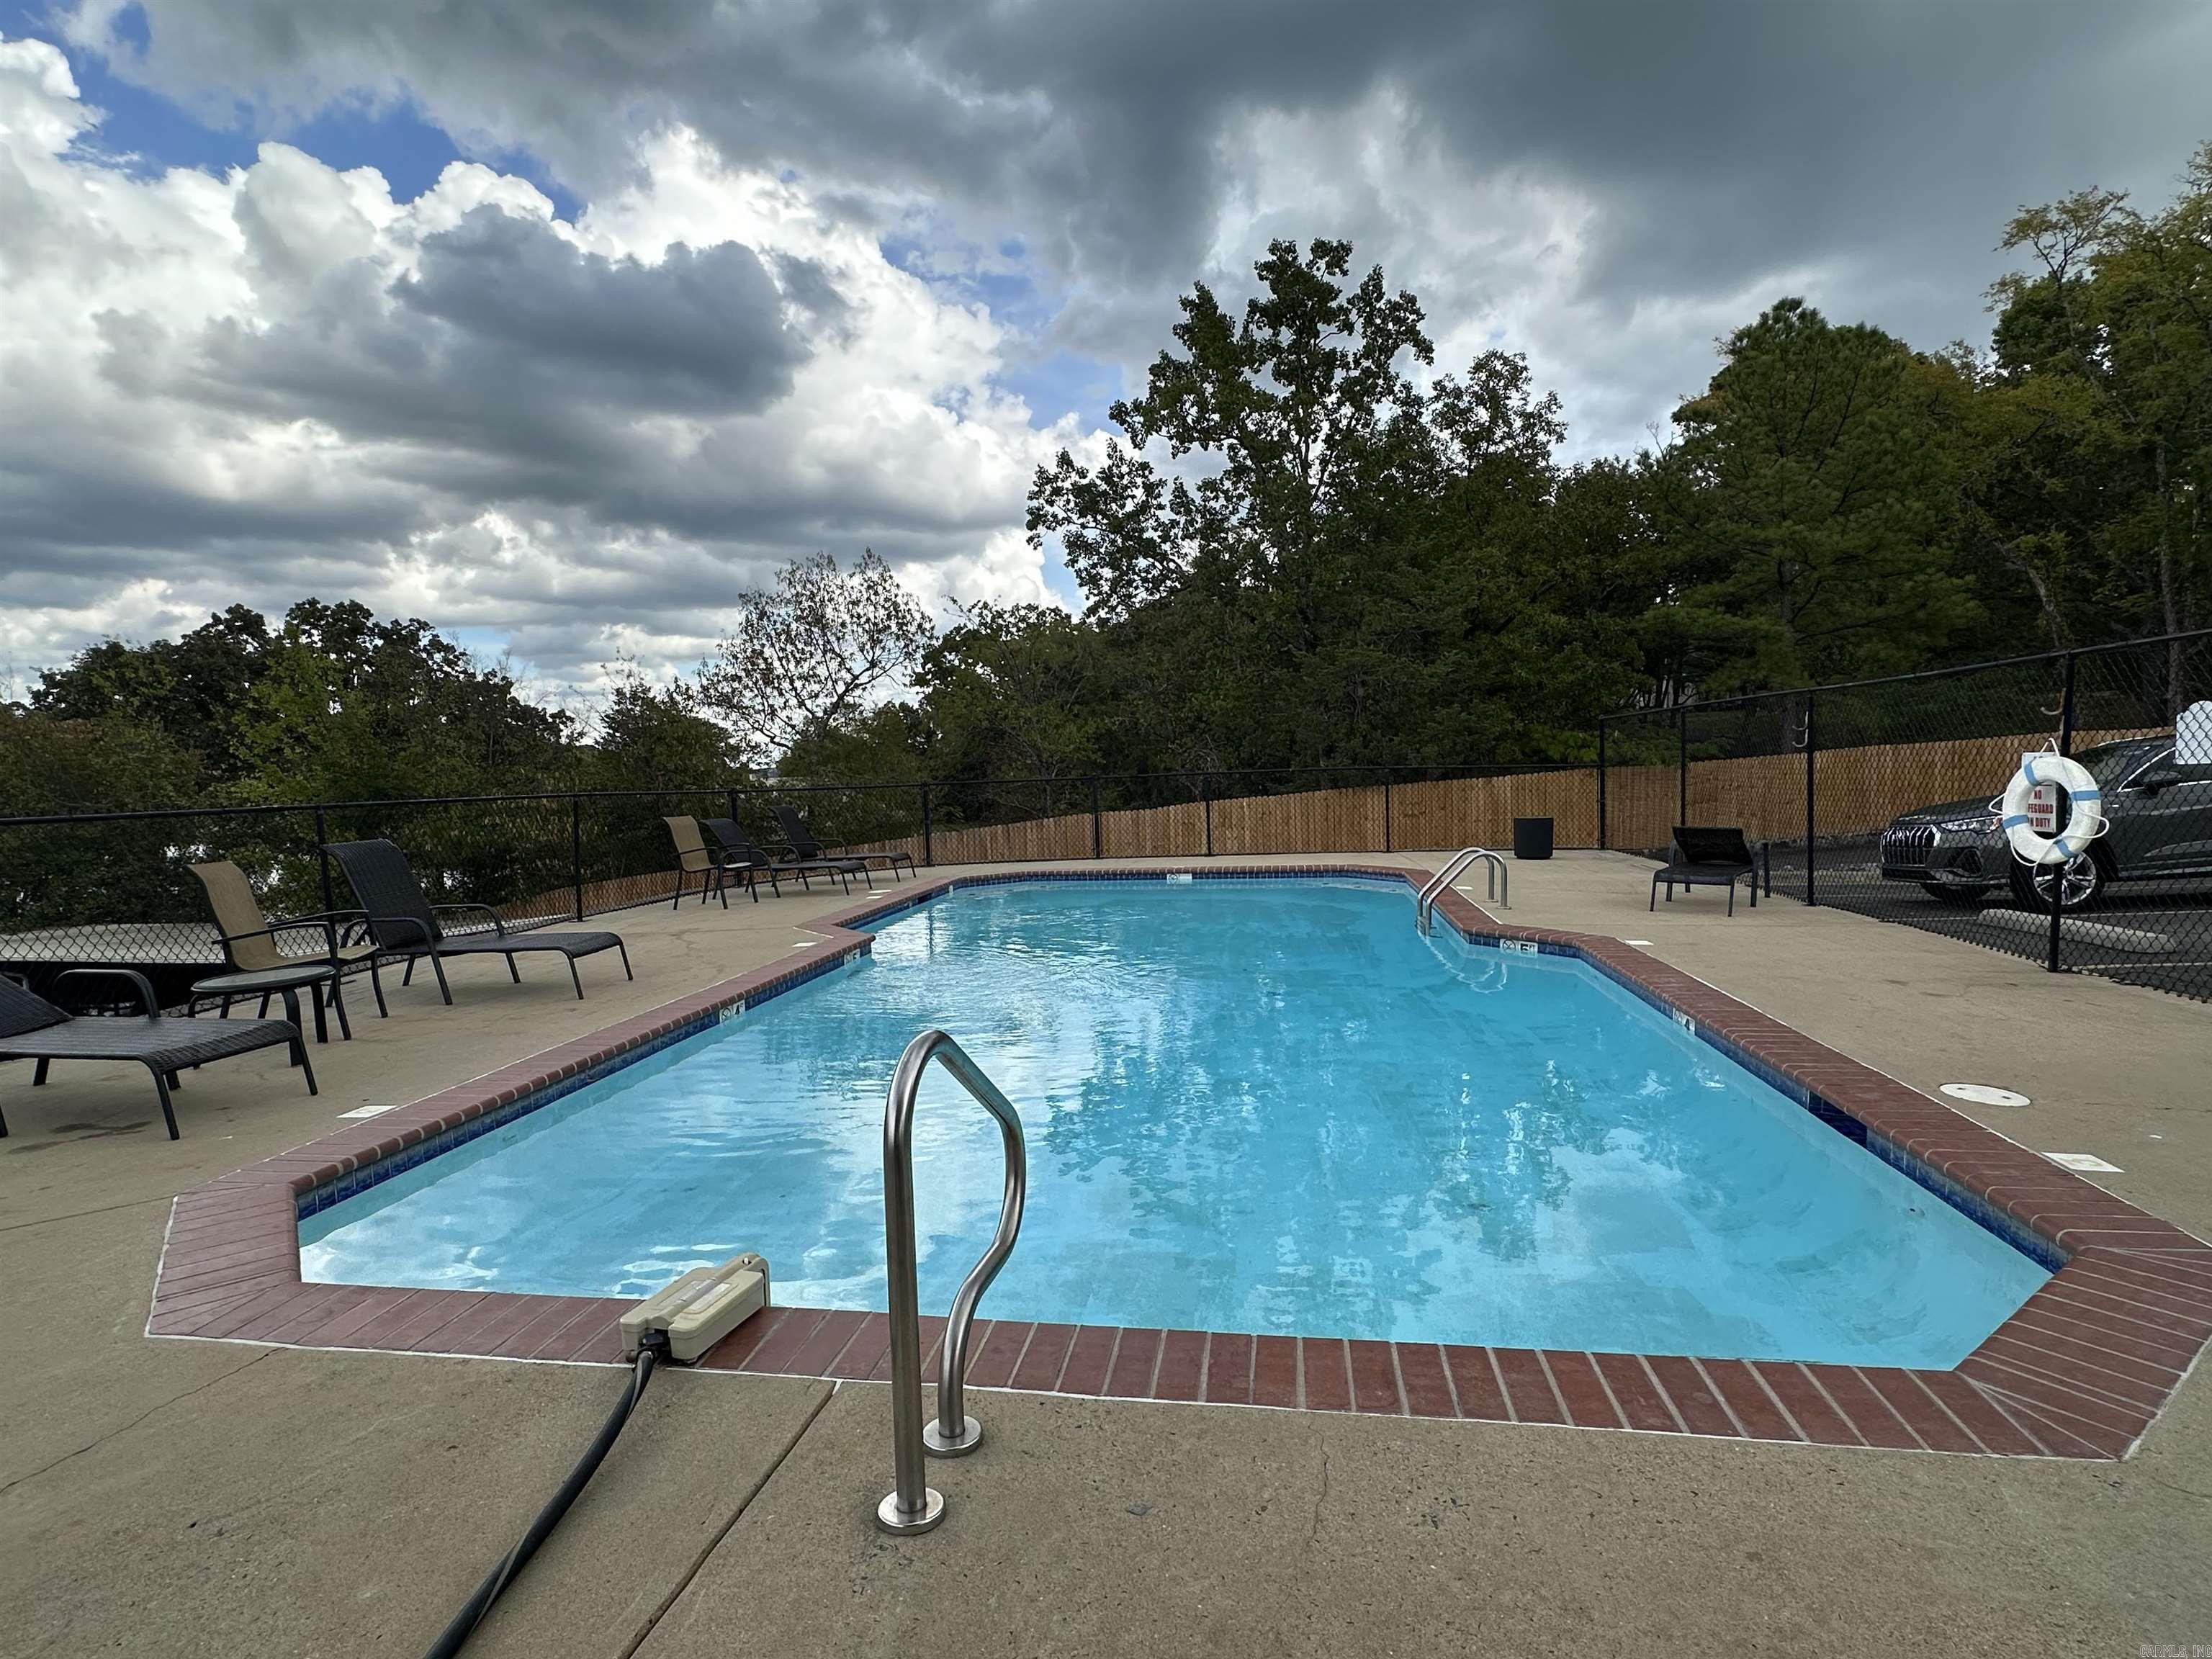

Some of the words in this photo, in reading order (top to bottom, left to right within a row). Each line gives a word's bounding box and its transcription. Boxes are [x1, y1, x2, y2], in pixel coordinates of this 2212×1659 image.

[2034, 790, 2042, 799] NO
[2028, 804, 2054, 814] FEGUARD
[2036, 817, 2051, 827] DUTY
[1520, 943, 1529, 953] 5
